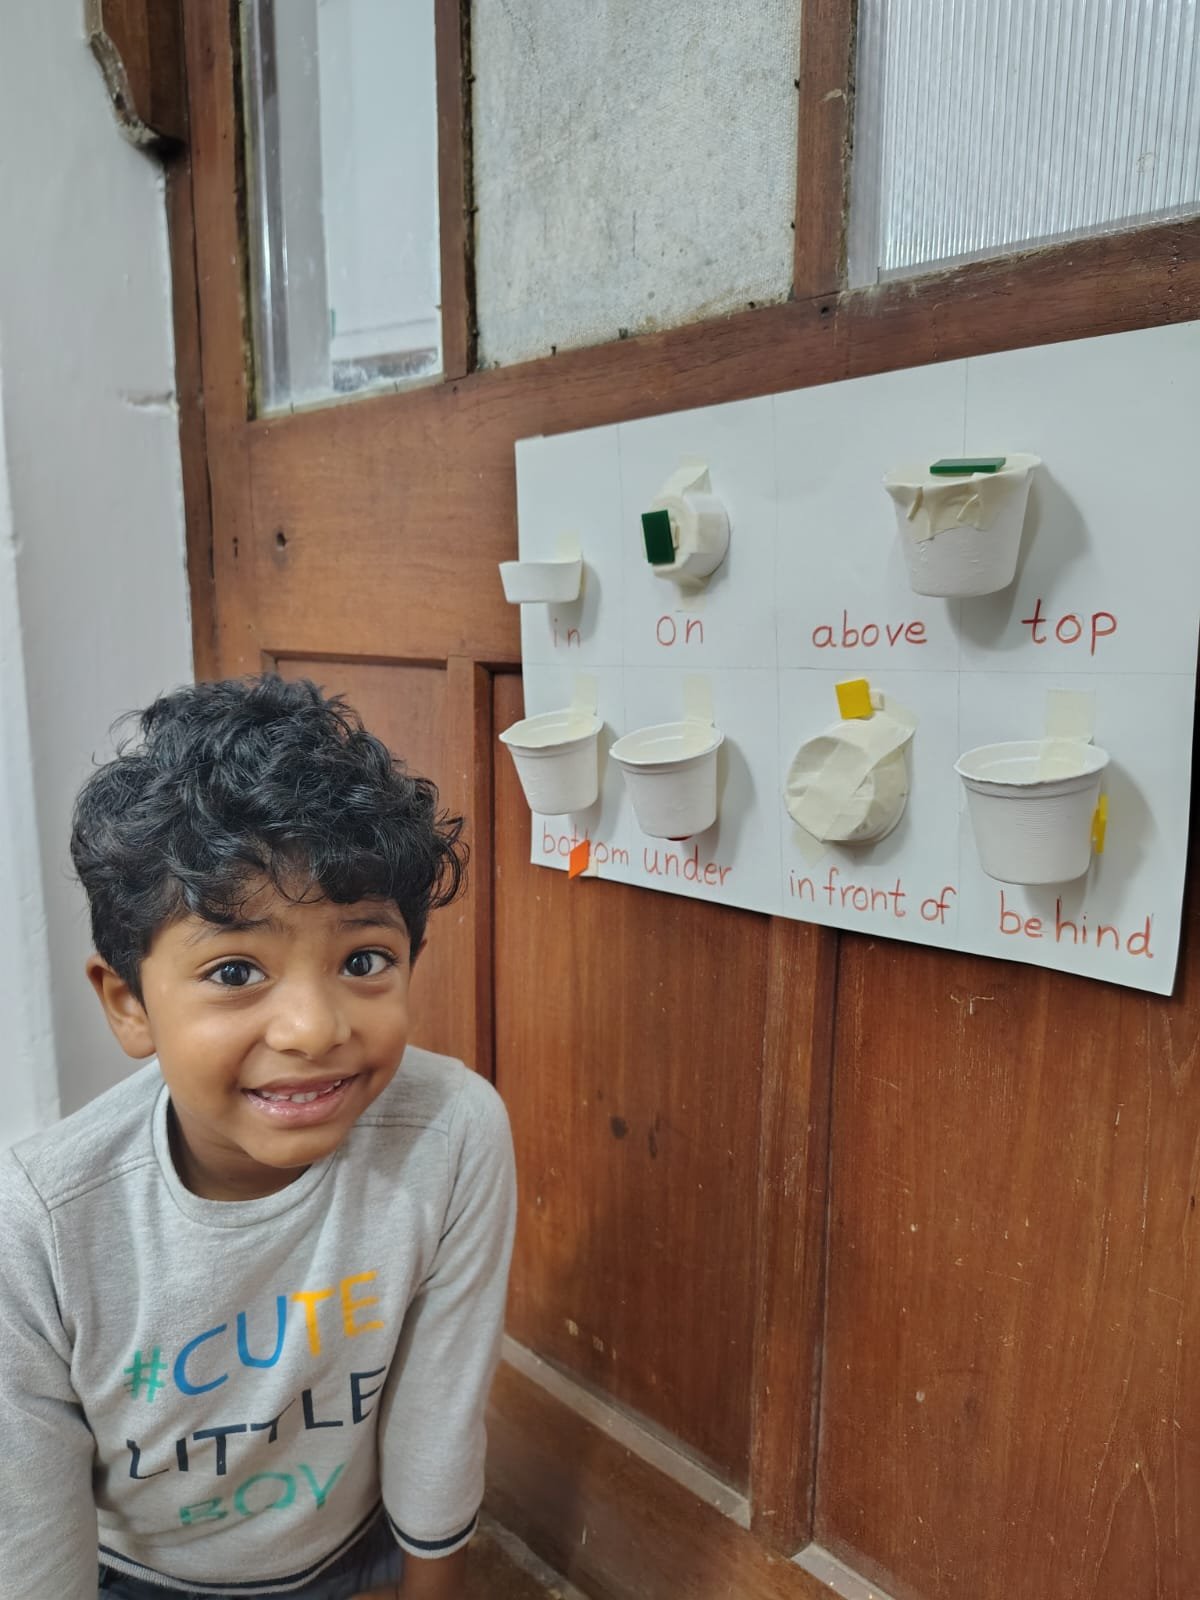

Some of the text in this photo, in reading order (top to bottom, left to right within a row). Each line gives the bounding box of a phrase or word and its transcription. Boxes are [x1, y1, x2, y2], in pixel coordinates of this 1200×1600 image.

[552, 617, 582, 648] in
[812, 610, 928, 648] above
[1021, 598, 1118, 655] top
[643, 845, 732, 886] under
[788, 867, 957, 925] in front of
[999, 890, 1153, 959] behind
[123, 1271, 385, 1403] #CUTE
